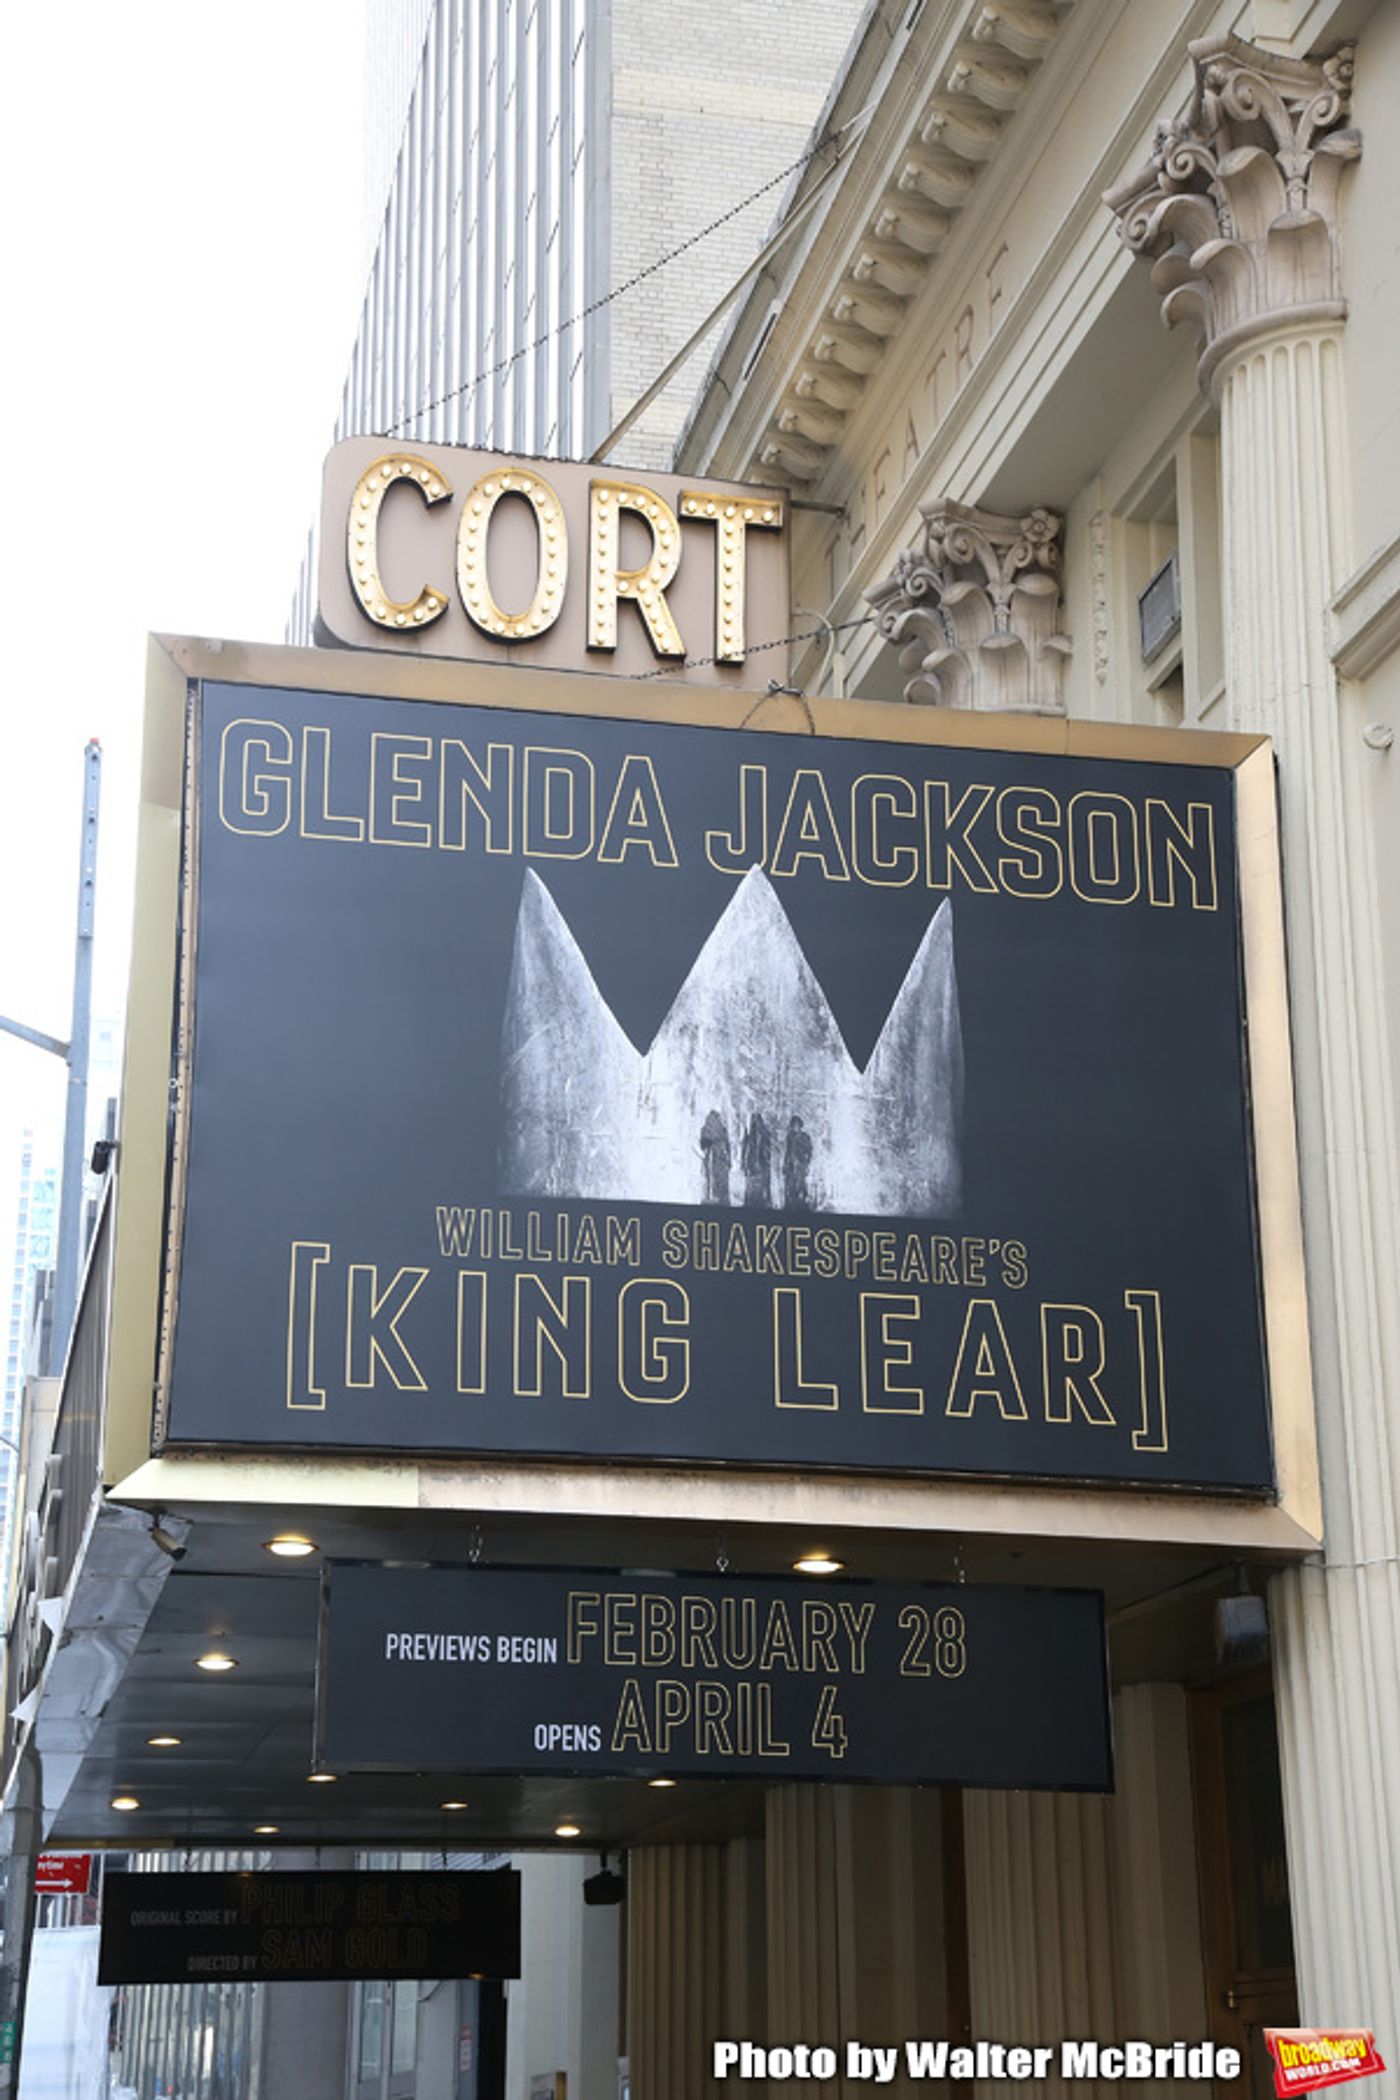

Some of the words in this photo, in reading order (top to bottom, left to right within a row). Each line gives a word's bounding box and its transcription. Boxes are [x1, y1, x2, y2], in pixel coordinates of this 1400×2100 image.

[346, 452, 783, 666] CORT
[217, 718, 680, 868] GLENDA
[705, 761, 1219, 912] JACKSON
[436, 1206, 641, 1266] WILLIAM
[662, 1218, 1029, 1289] SHAKESPEARE'S
[386, 1633, 490, 1662] PREVIEWS
[497, 1637, 558, 1664] BEGIN
[566, 1591, 875, 1673] FEBRUARY
[898, 1605, 967, 1677] 28
[534, 1724, 601, 1752] OPENS
[611, 1679, 790, 1757] APRIL
[811, 1685, 848, 1758] 4
[130, 1910, 181, 1926] ORIGINAL
[184, 1910, 220, 1925] SCORE
[223, 1910, 239, 1925] BY
[241, 1883, 346, 1925] PHILIP
[356, 1883, 462, 1924] GLASS
[188, 1955, 240, 1971] DIRECTED
[242, 1955, 258, 1971] BY
[261, 1927, 334, 1969] SAM
[344, 1926, 432, 1969] GOLD
